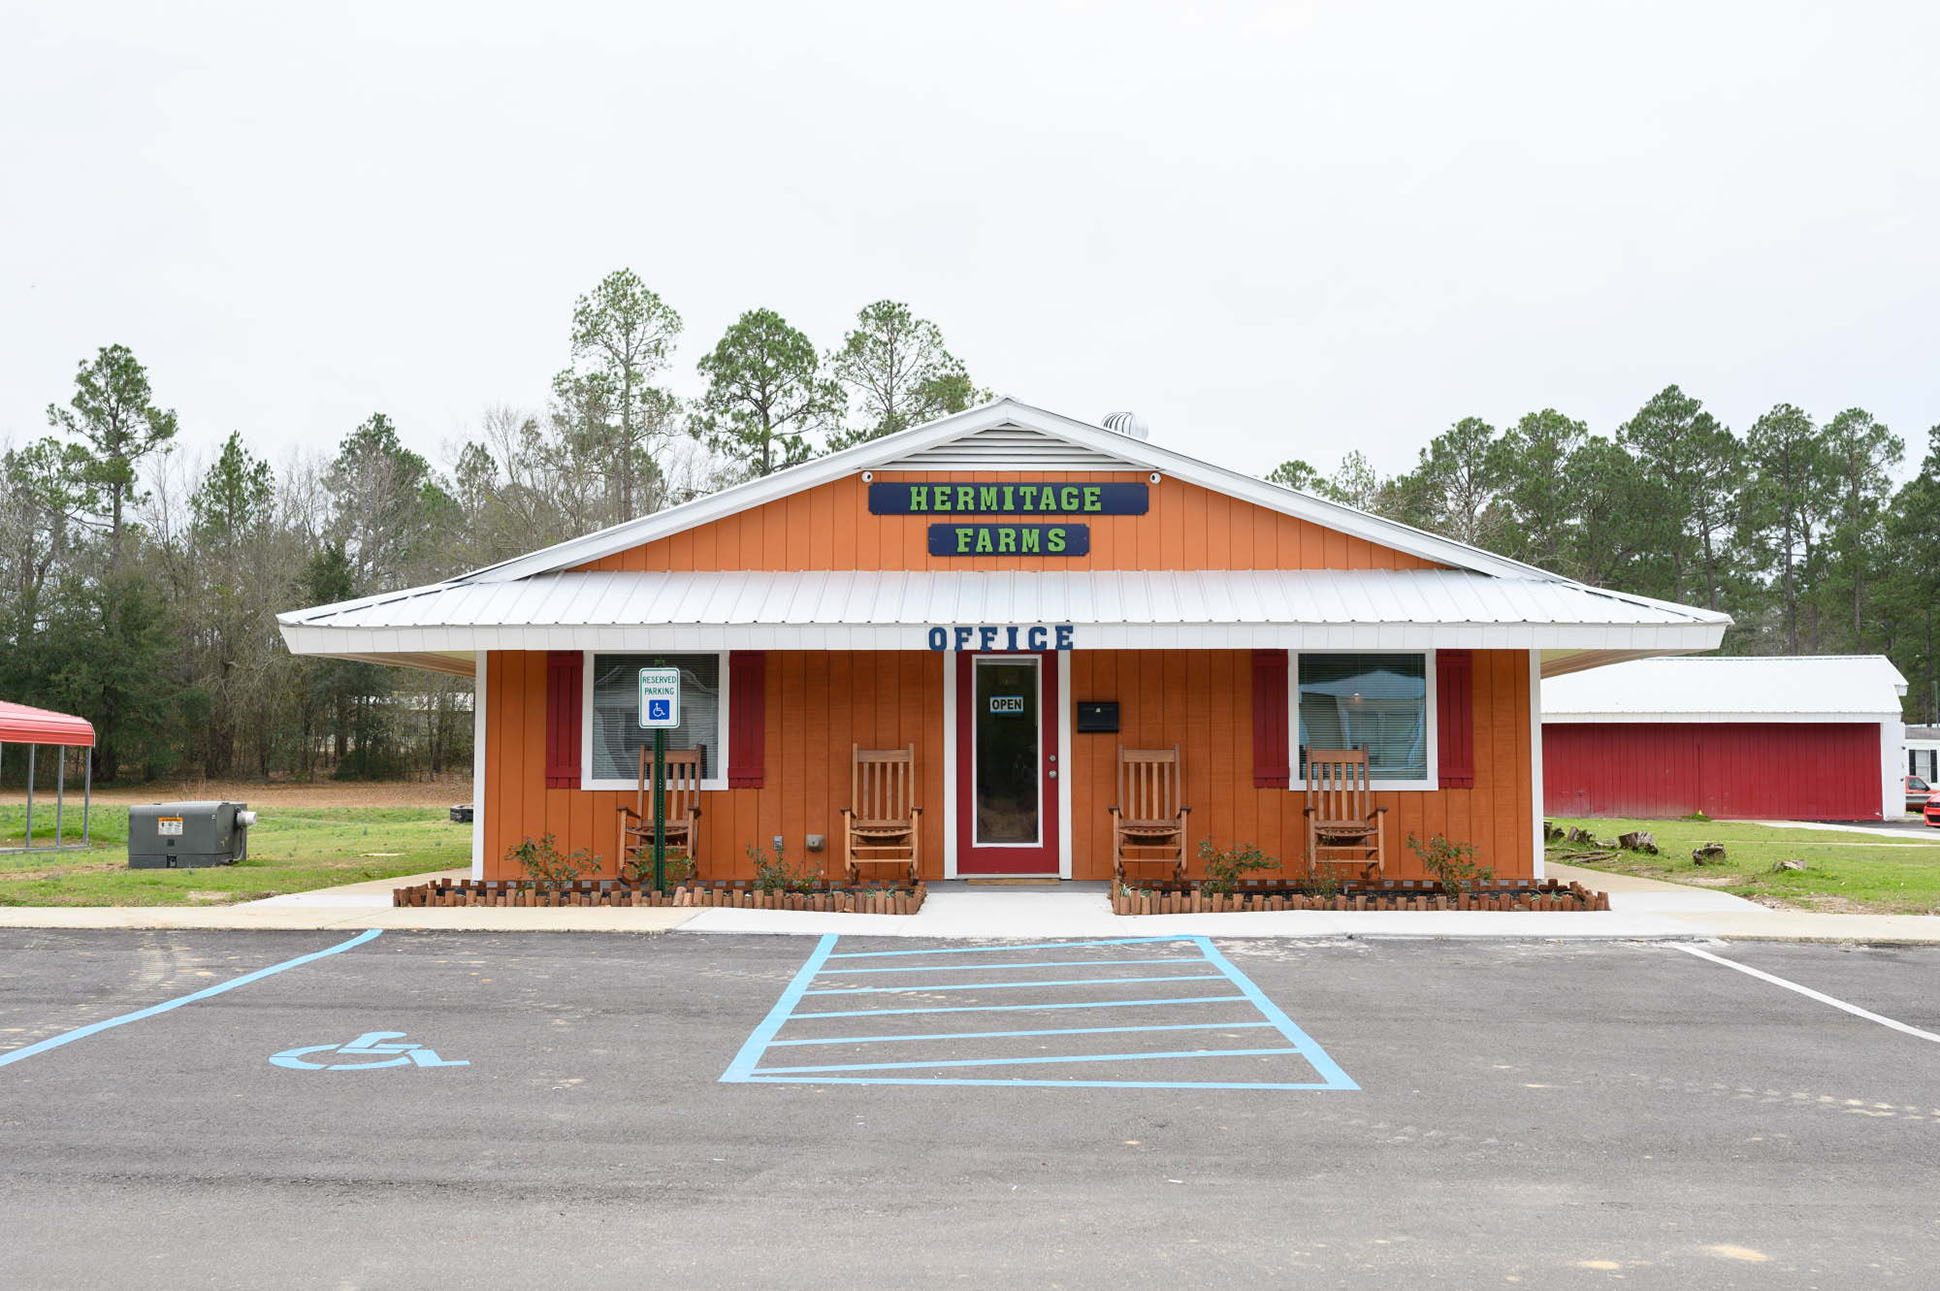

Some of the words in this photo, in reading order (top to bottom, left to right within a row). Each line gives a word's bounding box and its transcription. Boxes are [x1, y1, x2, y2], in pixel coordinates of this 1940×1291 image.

[910, 486, 1102, 511] HERMITAGE
[955, 528, 1066, 553] FARMS
[928, 625, 1074, 651] OFFICE
[642, 676, 677, 684] RESERVED
[644, 687, 675, 695] PARKING
[991, 698, 1022, 711] OPEN
